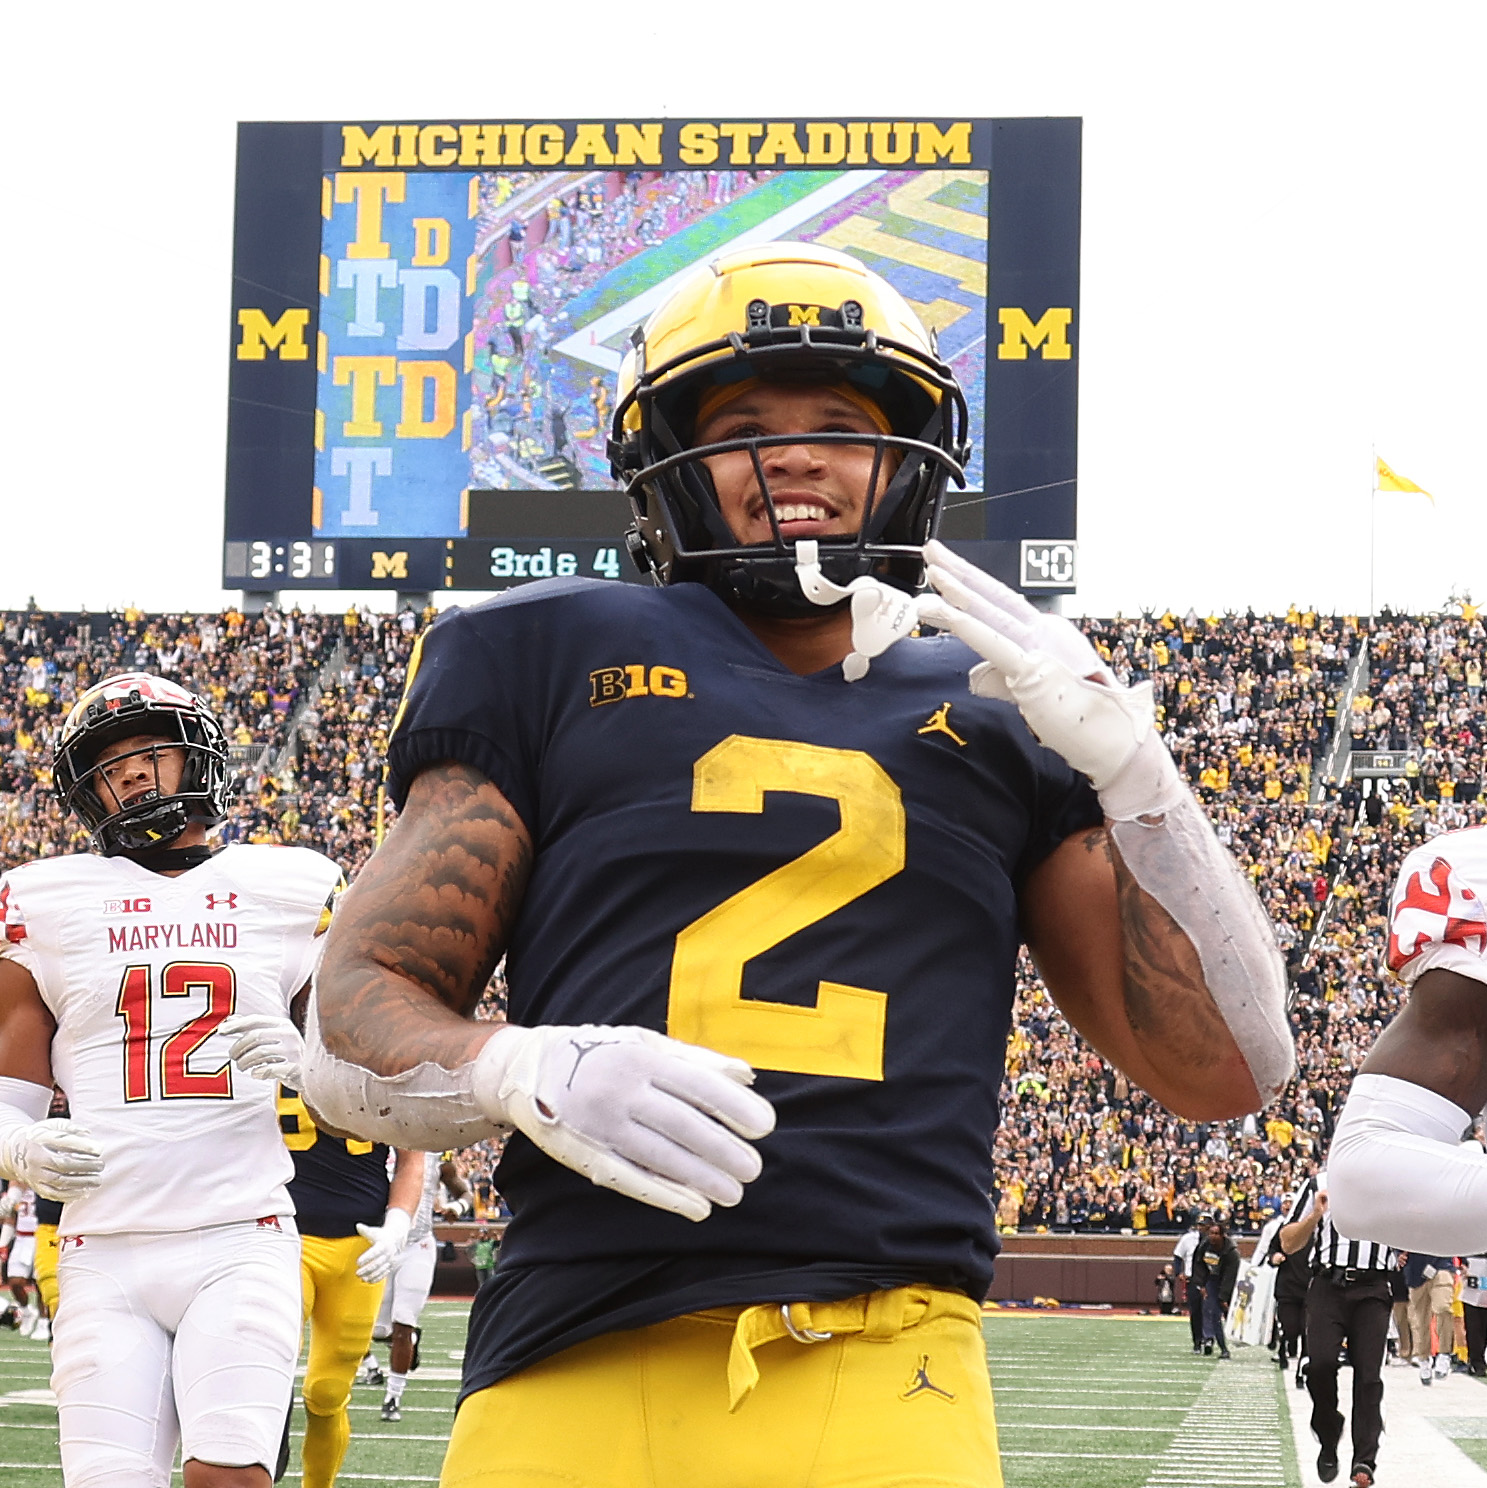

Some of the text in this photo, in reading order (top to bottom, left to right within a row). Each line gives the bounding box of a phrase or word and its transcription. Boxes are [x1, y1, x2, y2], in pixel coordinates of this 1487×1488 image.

[340, 121, 973, 167] MICHIGAN STADIUM
[236, 308, 310, 360] M
[788, 305, 820, 326] M
[997, 307, 1073, 360] M
[332, 355, 458, 439] TD
[247, 540, 335, 579] 3:31
[370, 551, 409, 579] M
[593, 547, 620, 578] 4
[1027, 545, 1073, 581] 40
[667, 734, 907, 1081] 2
[107, 922, 238, 954] MARYLAND
[115, 960, 236, 1105] 12
